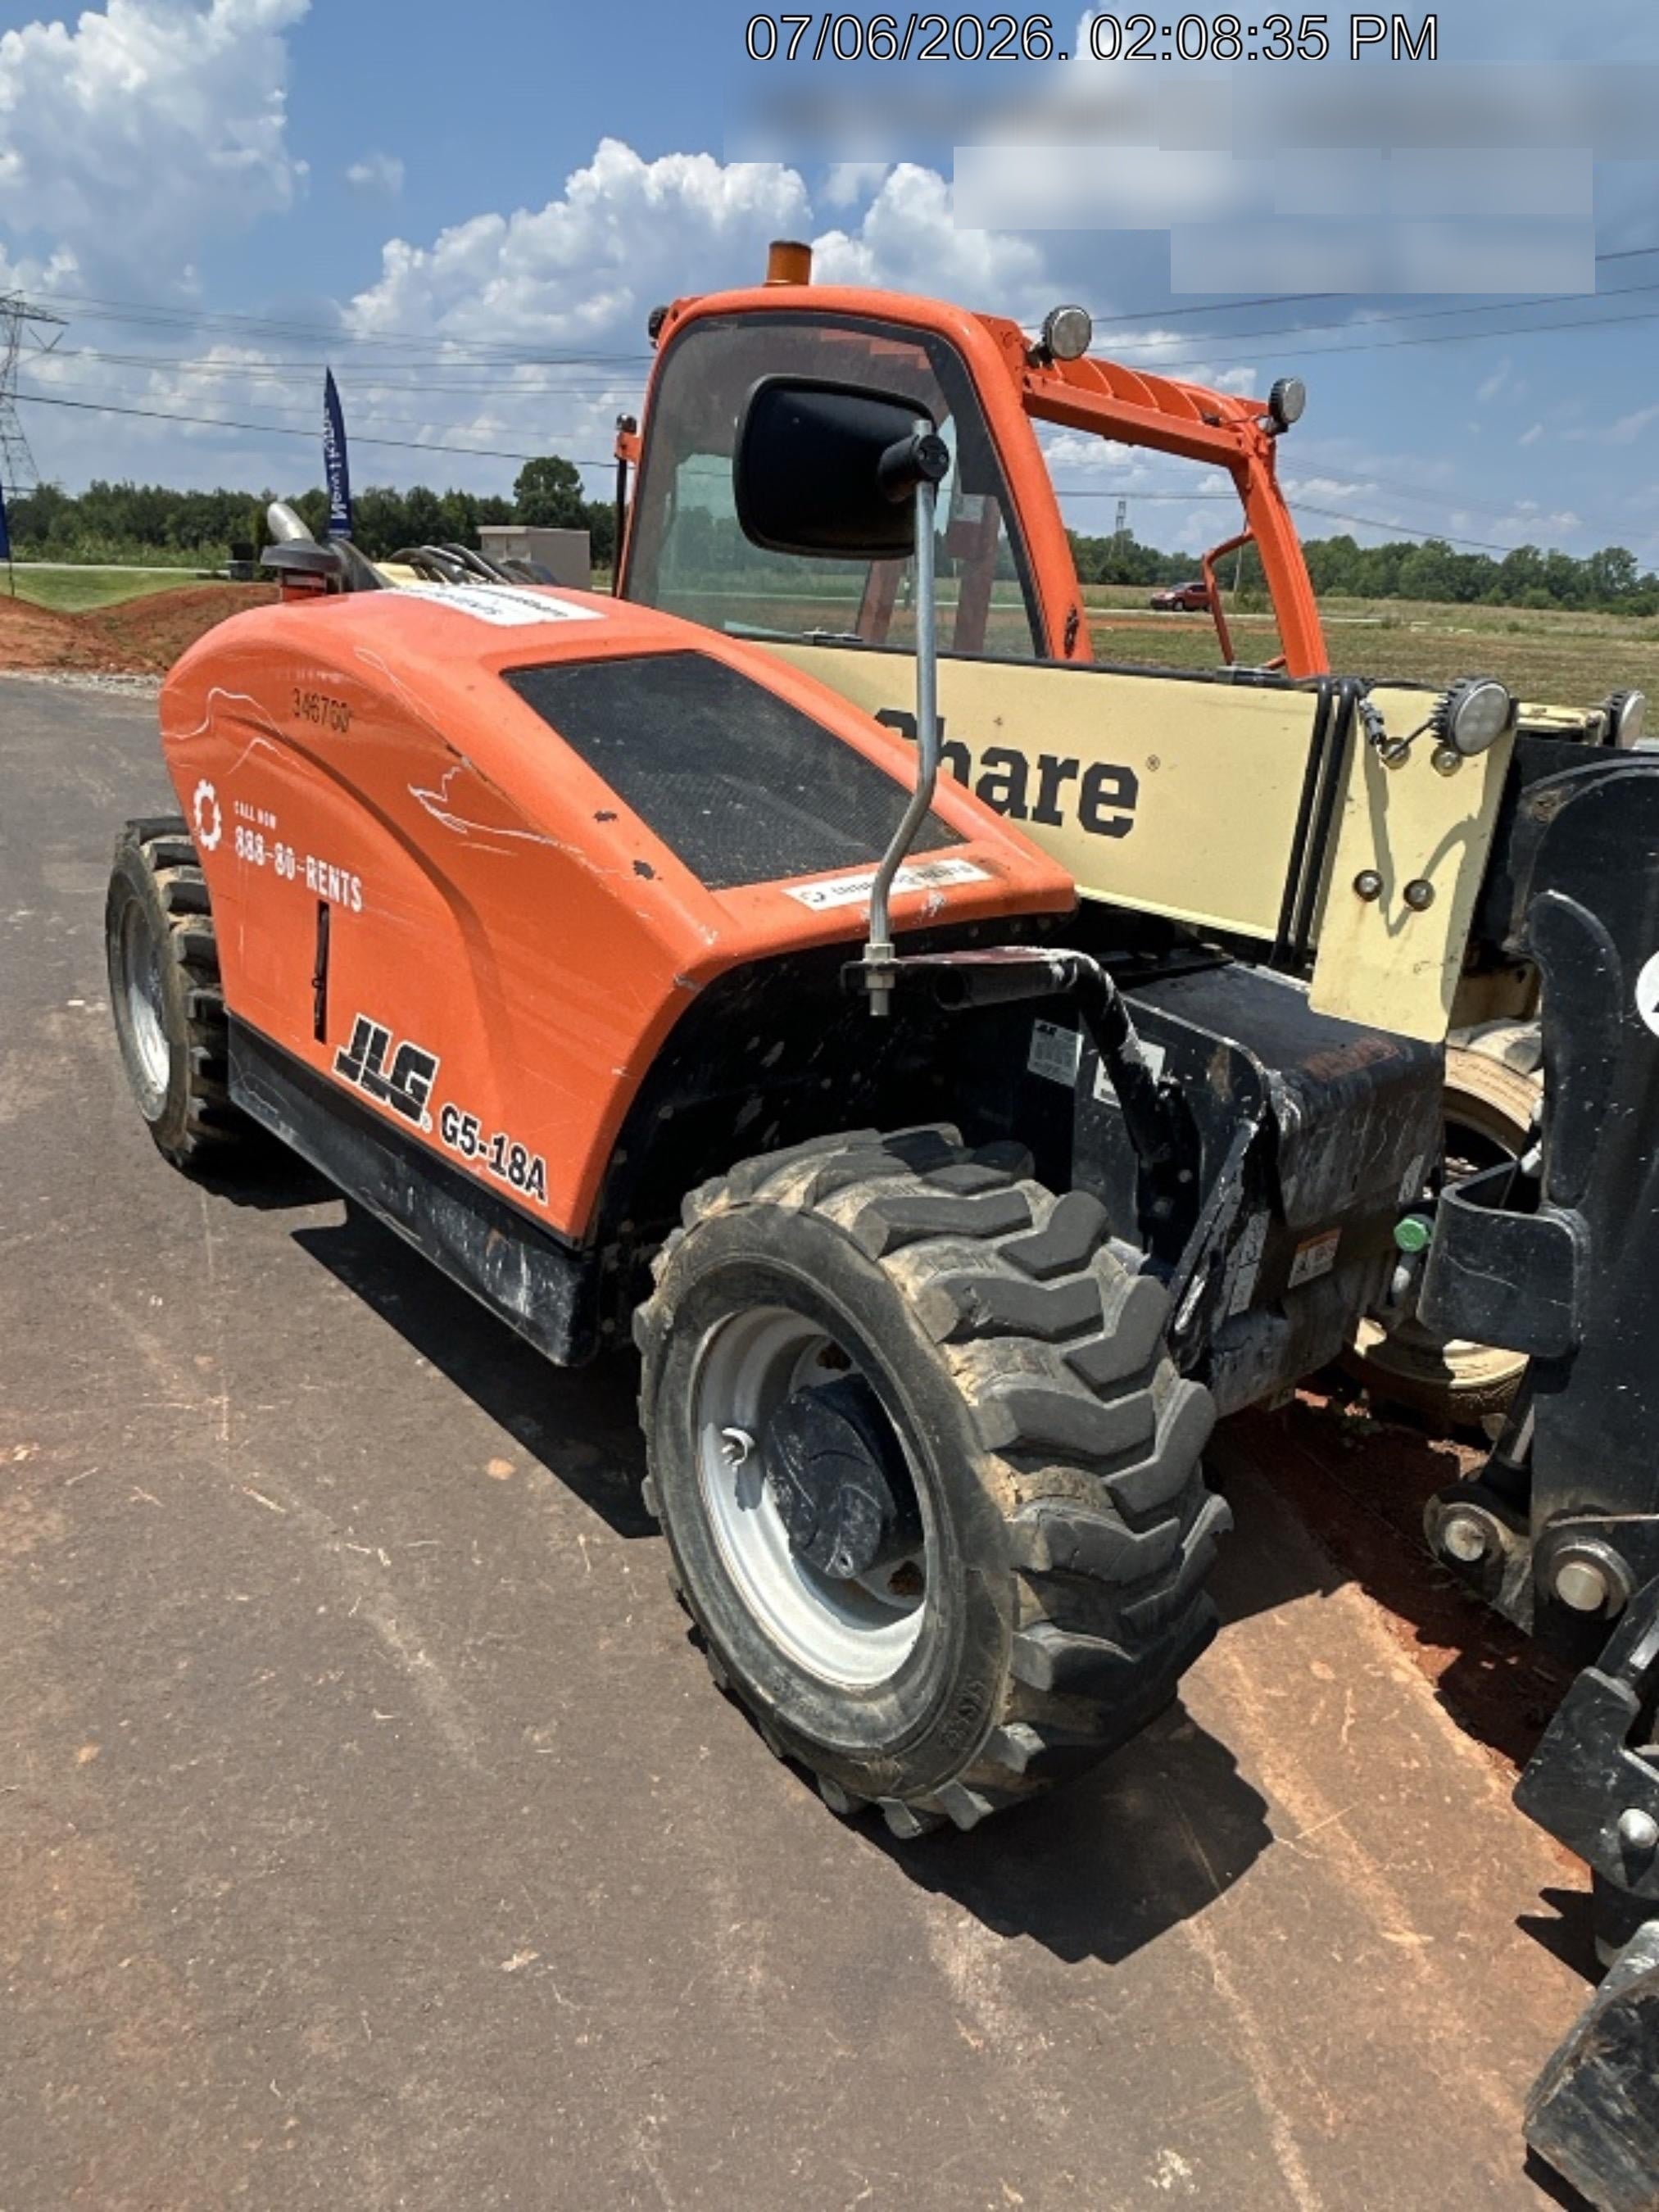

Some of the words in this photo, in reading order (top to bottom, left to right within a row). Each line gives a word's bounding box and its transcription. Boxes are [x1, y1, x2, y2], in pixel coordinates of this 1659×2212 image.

[235, 825, 362, 913] 888-80-RENTS
[333, 1013, 440, 1128] JLG
[439, 1103, 548, 1207] G5-18A
